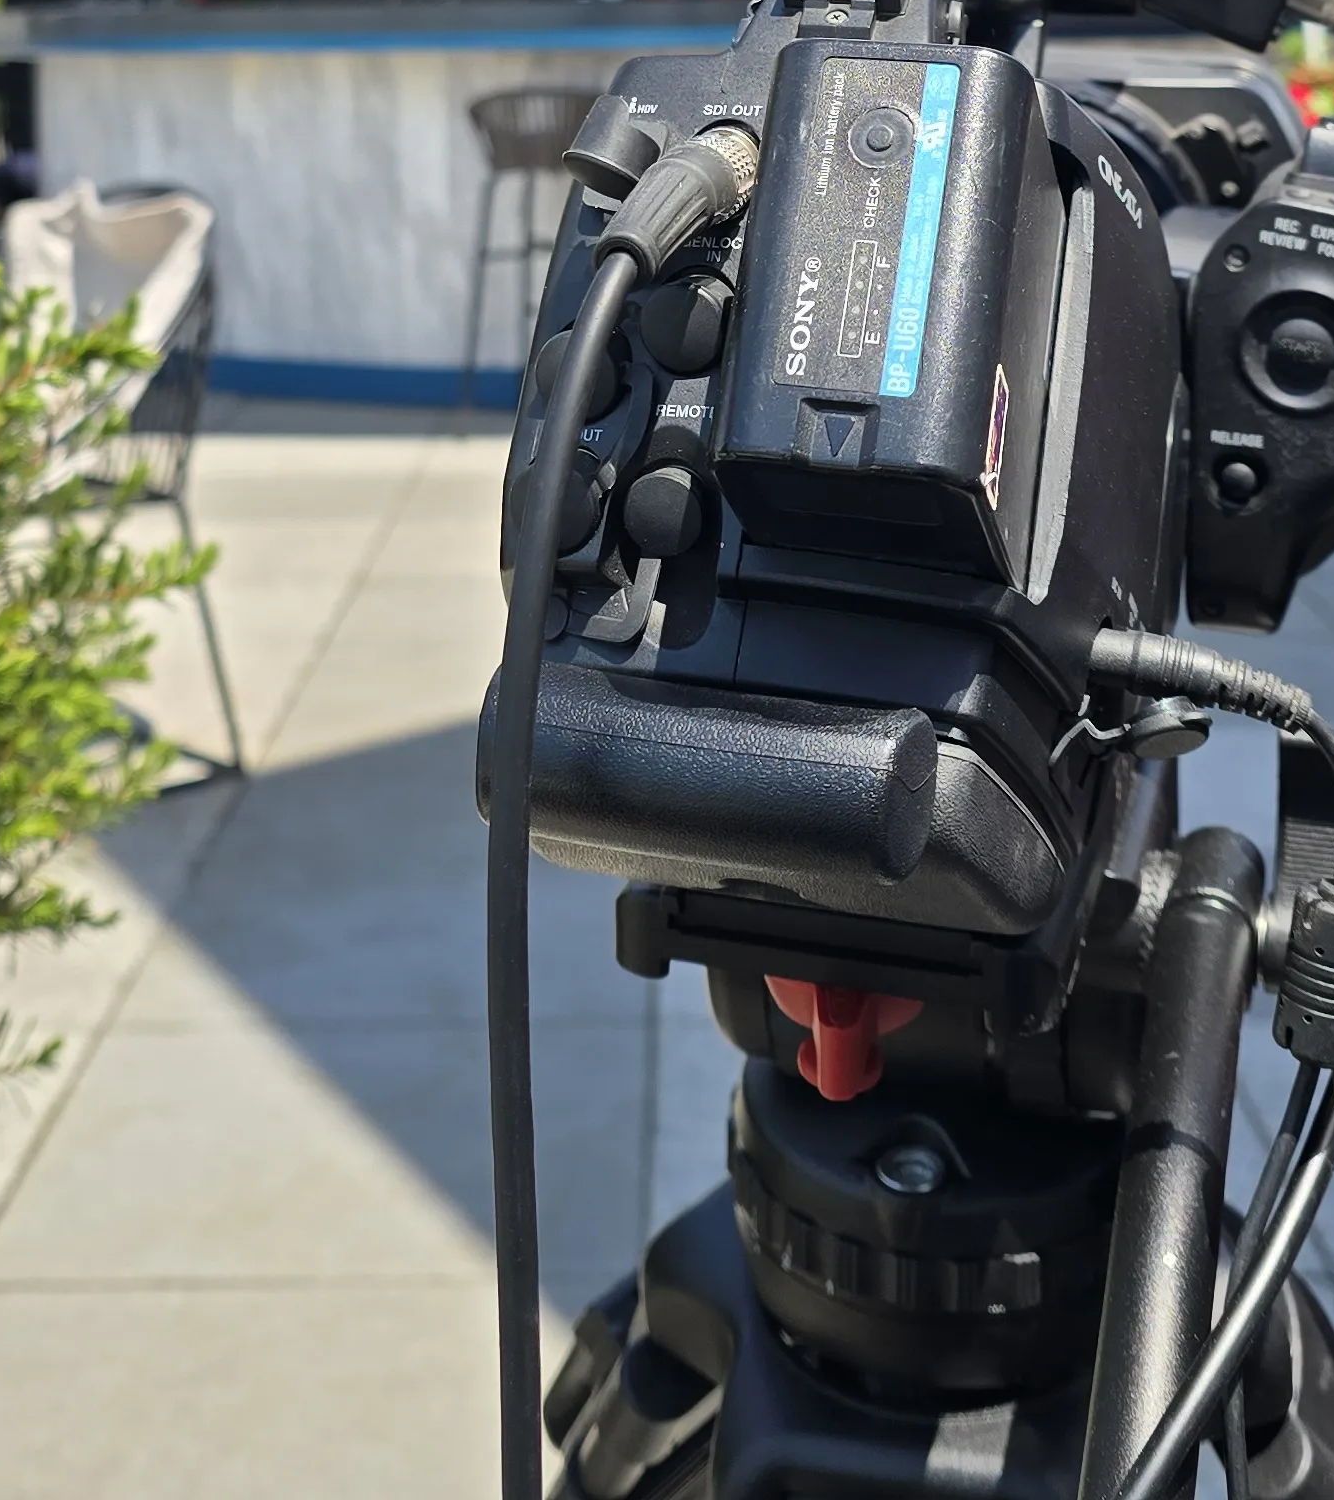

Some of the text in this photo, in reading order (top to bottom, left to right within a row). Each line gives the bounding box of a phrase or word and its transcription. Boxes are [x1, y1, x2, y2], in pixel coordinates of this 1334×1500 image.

[834, 72, 846, 97] pack
[702, 104, 763, 116] SDI OUT
[826, 100, 844, 136] battery
[815, 158, 832, 197] Lithium
[864, 176, 882, 228] CHECK
[1274, 216, 1302, 234] REC
[683, 235, 743, 249] ENLOC
[1258, 229, 1308, 251] REVIEW
[706, 250, 721, 262] IN
[865, 256, 890, 344] E F
[886, 307, 921, 393] BP-U60
[581, 428, 603, 441] UT
